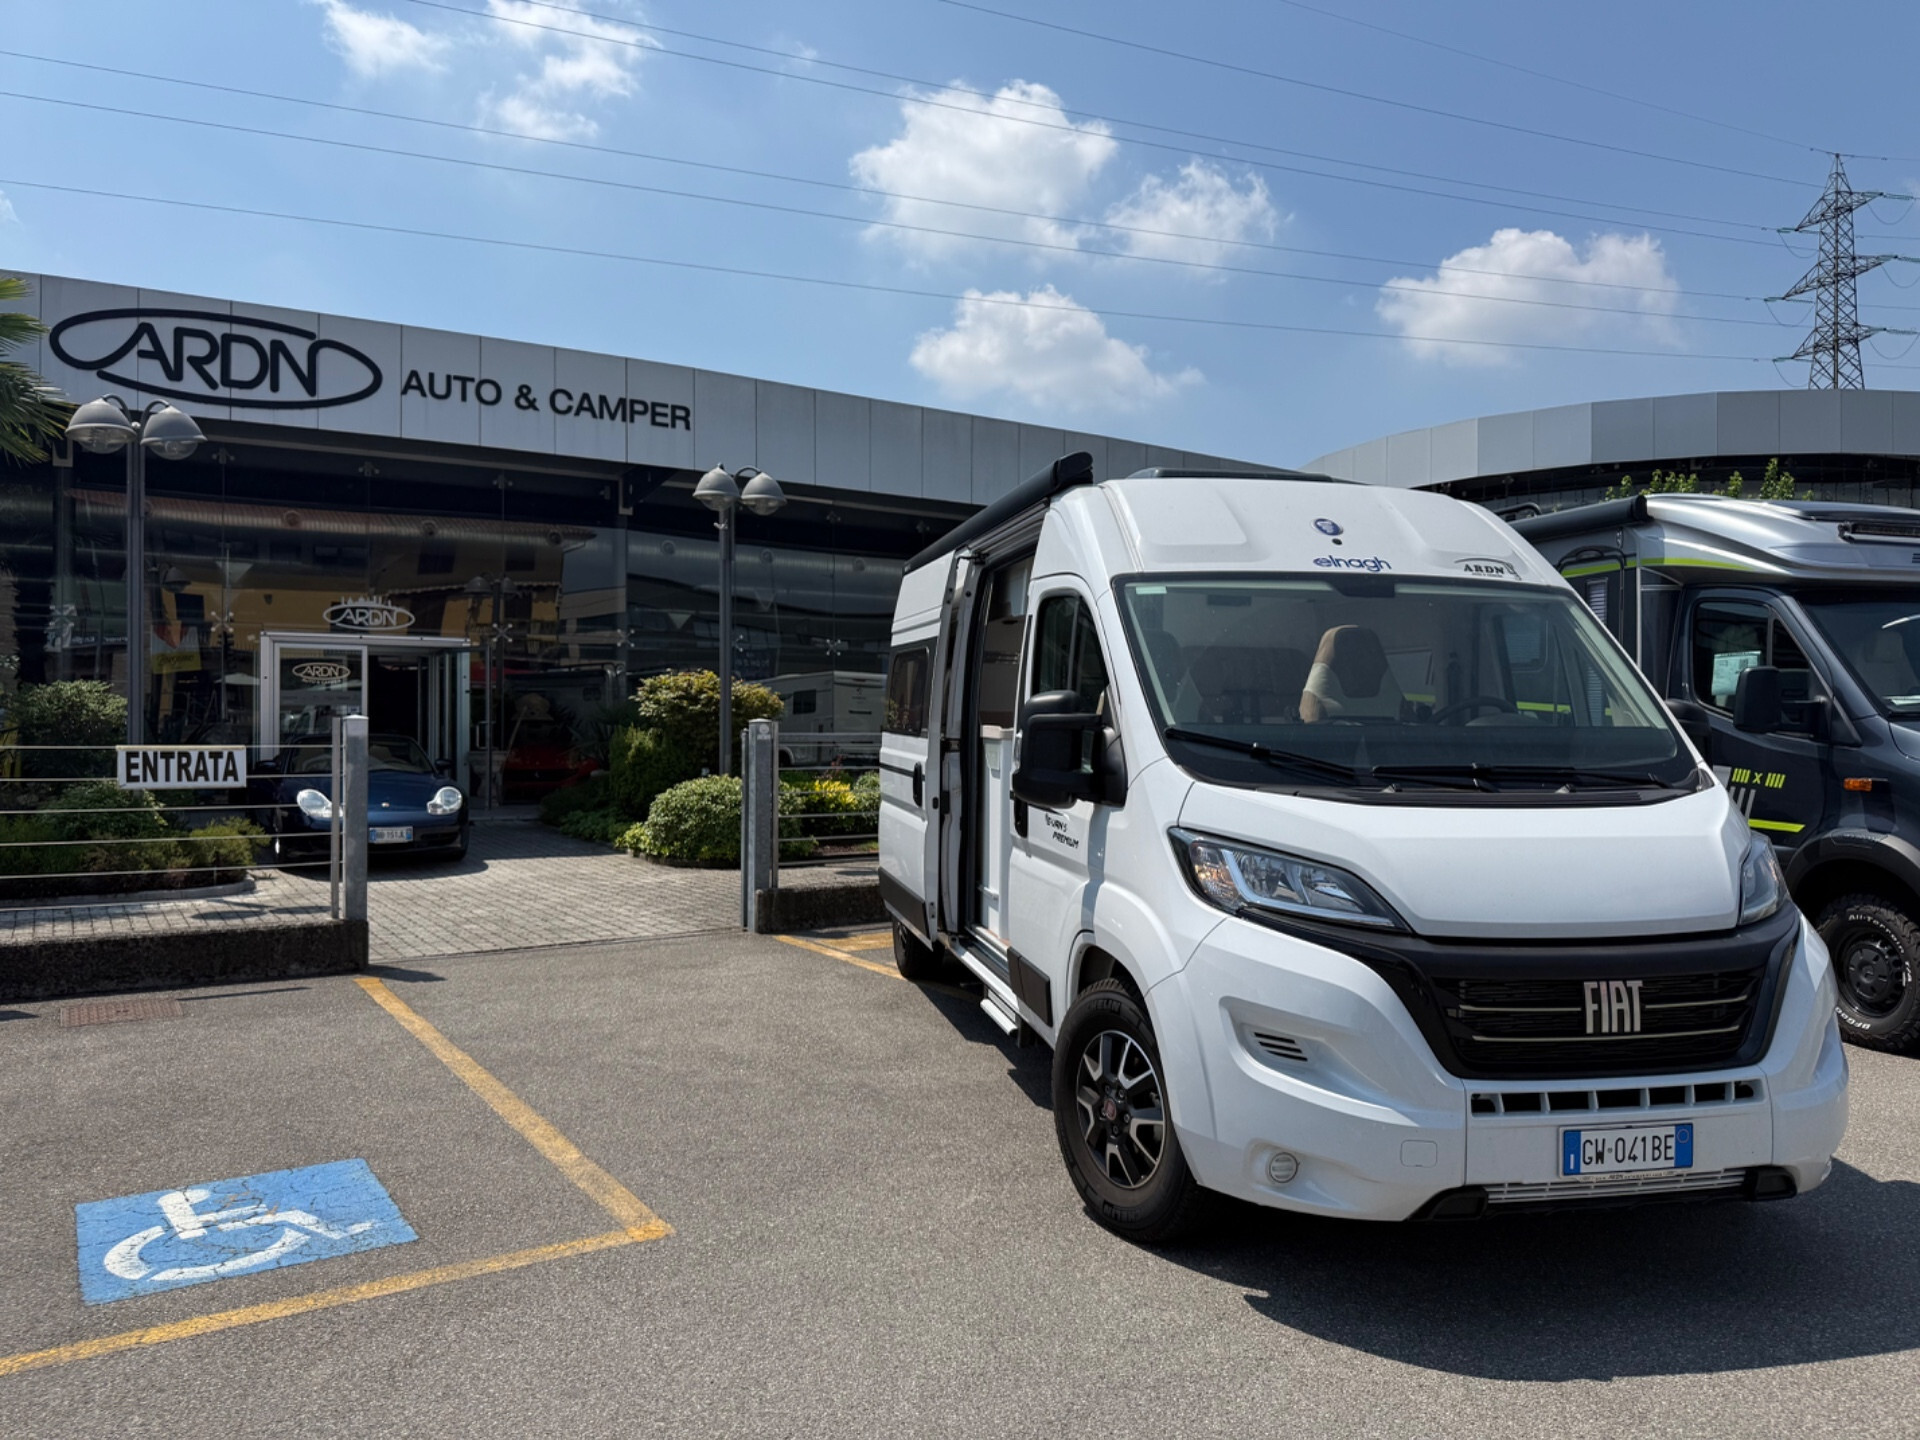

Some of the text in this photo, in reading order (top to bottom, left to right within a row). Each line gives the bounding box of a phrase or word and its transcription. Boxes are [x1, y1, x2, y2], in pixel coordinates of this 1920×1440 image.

[100, 316, 332, 402] ARDN
[400, 369, 692, 431] AUTO & CAMPER
[1313, 555, 1392, 573] elnagh
[1463, 564, 1505, 575] ARDN
[335, 607, 402, 628] ARDN
[125, 751, 239, 783] ENTRATA
[1583, 980, 1643, 1034] FIAT
[1582, 1134, 1676, 1166] GW 041BE
